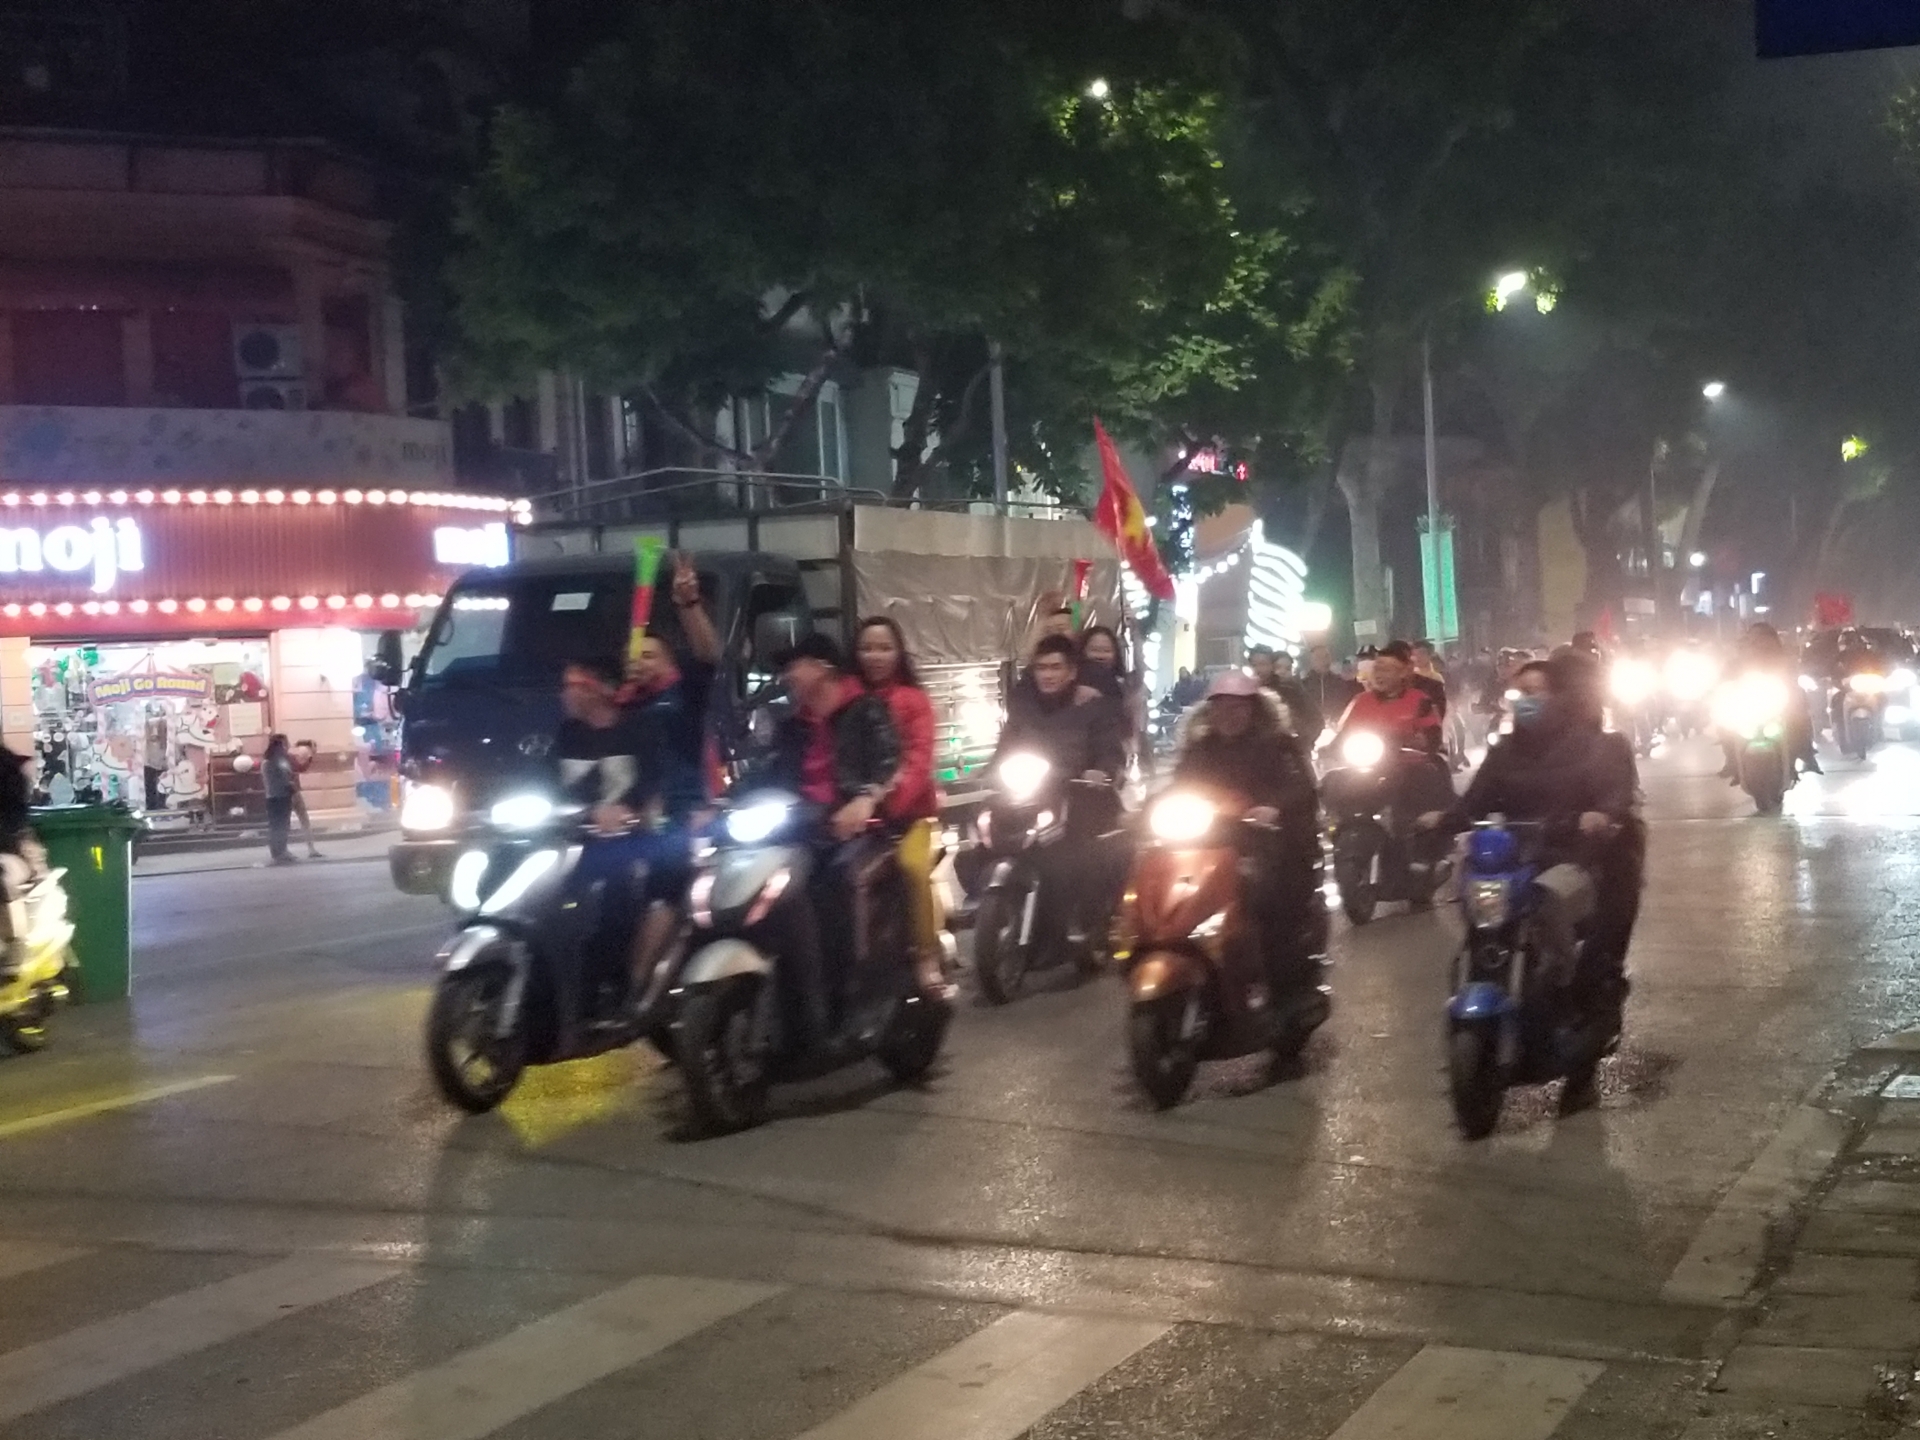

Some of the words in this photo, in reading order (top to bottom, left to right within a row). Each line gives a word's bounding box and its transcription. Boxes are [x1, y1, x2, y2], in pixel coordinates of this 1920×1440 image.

[0, 516, 144, 593] moji
[96, 679, 131, 698] Moji
[134, 678, 154, 690] Go
